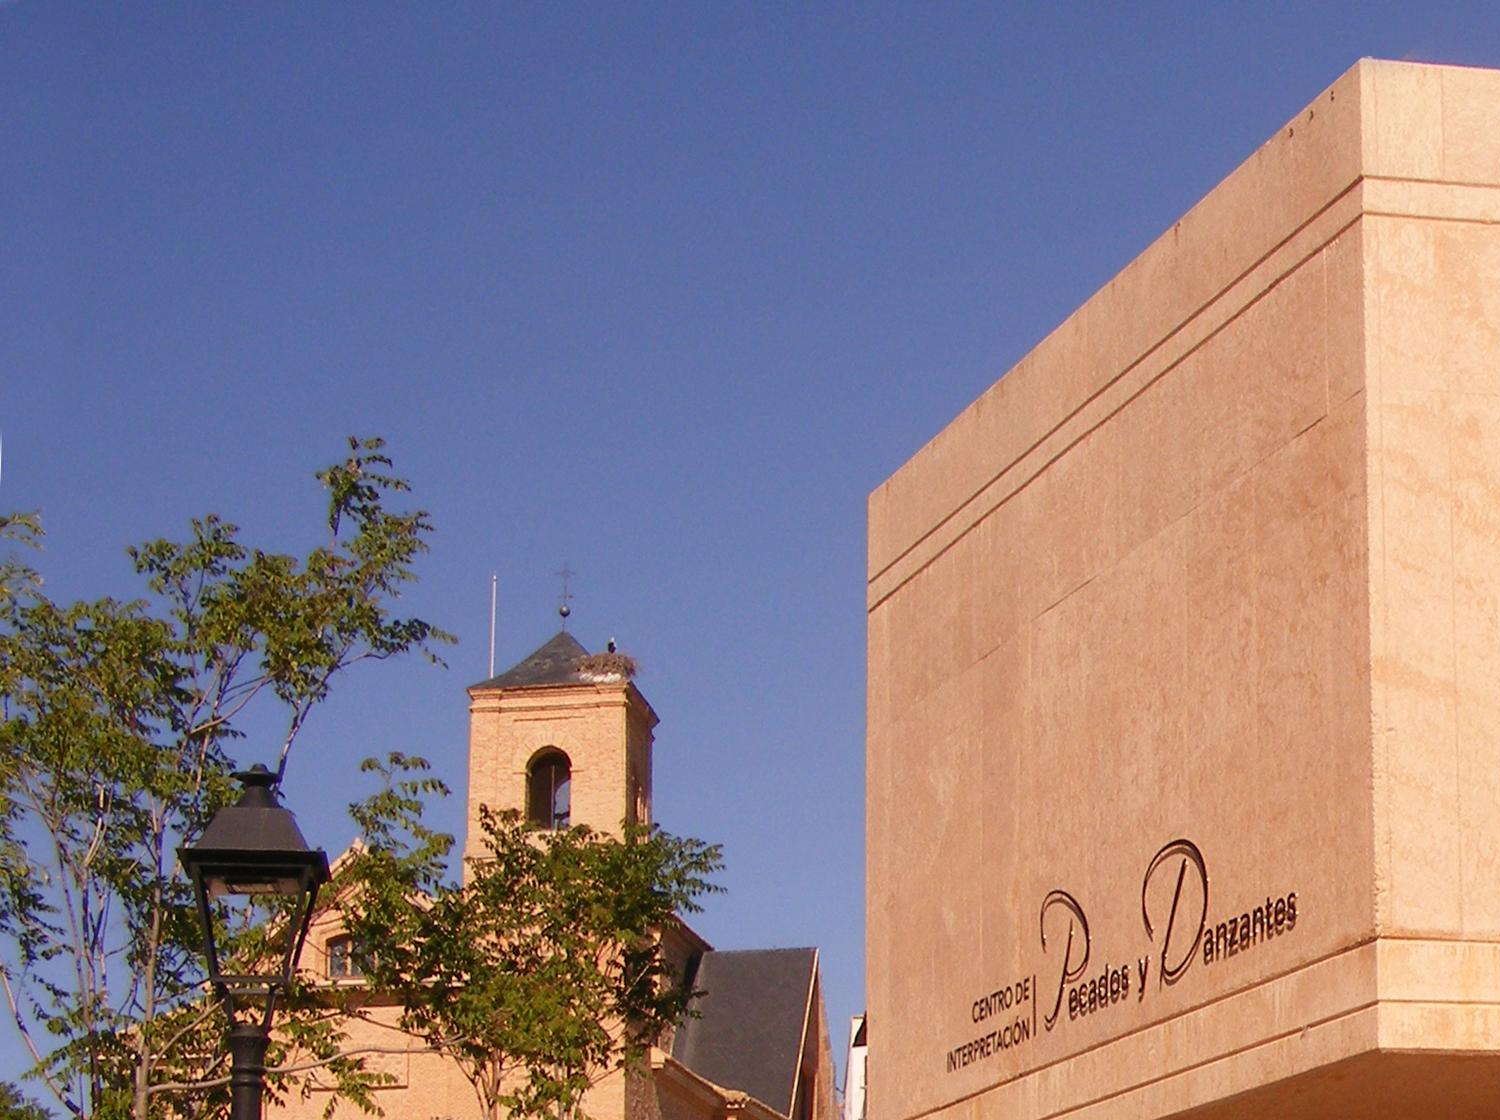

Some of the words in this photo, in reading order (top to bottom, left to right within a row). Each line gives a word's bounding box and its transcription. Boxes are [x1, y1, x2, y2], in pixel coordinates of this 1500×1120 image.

[1141, 838, 1298, 983] Danzantes
[1039, 889, 1130, 1030] Pecados
[1137, 955, 1150, 1002] y
[972, 985, 1013, 1024] CENTRO
[1015, 977, 1030, 1005] DE
[946, 1016, 1030, 1073] INTERPRETACIÓN
